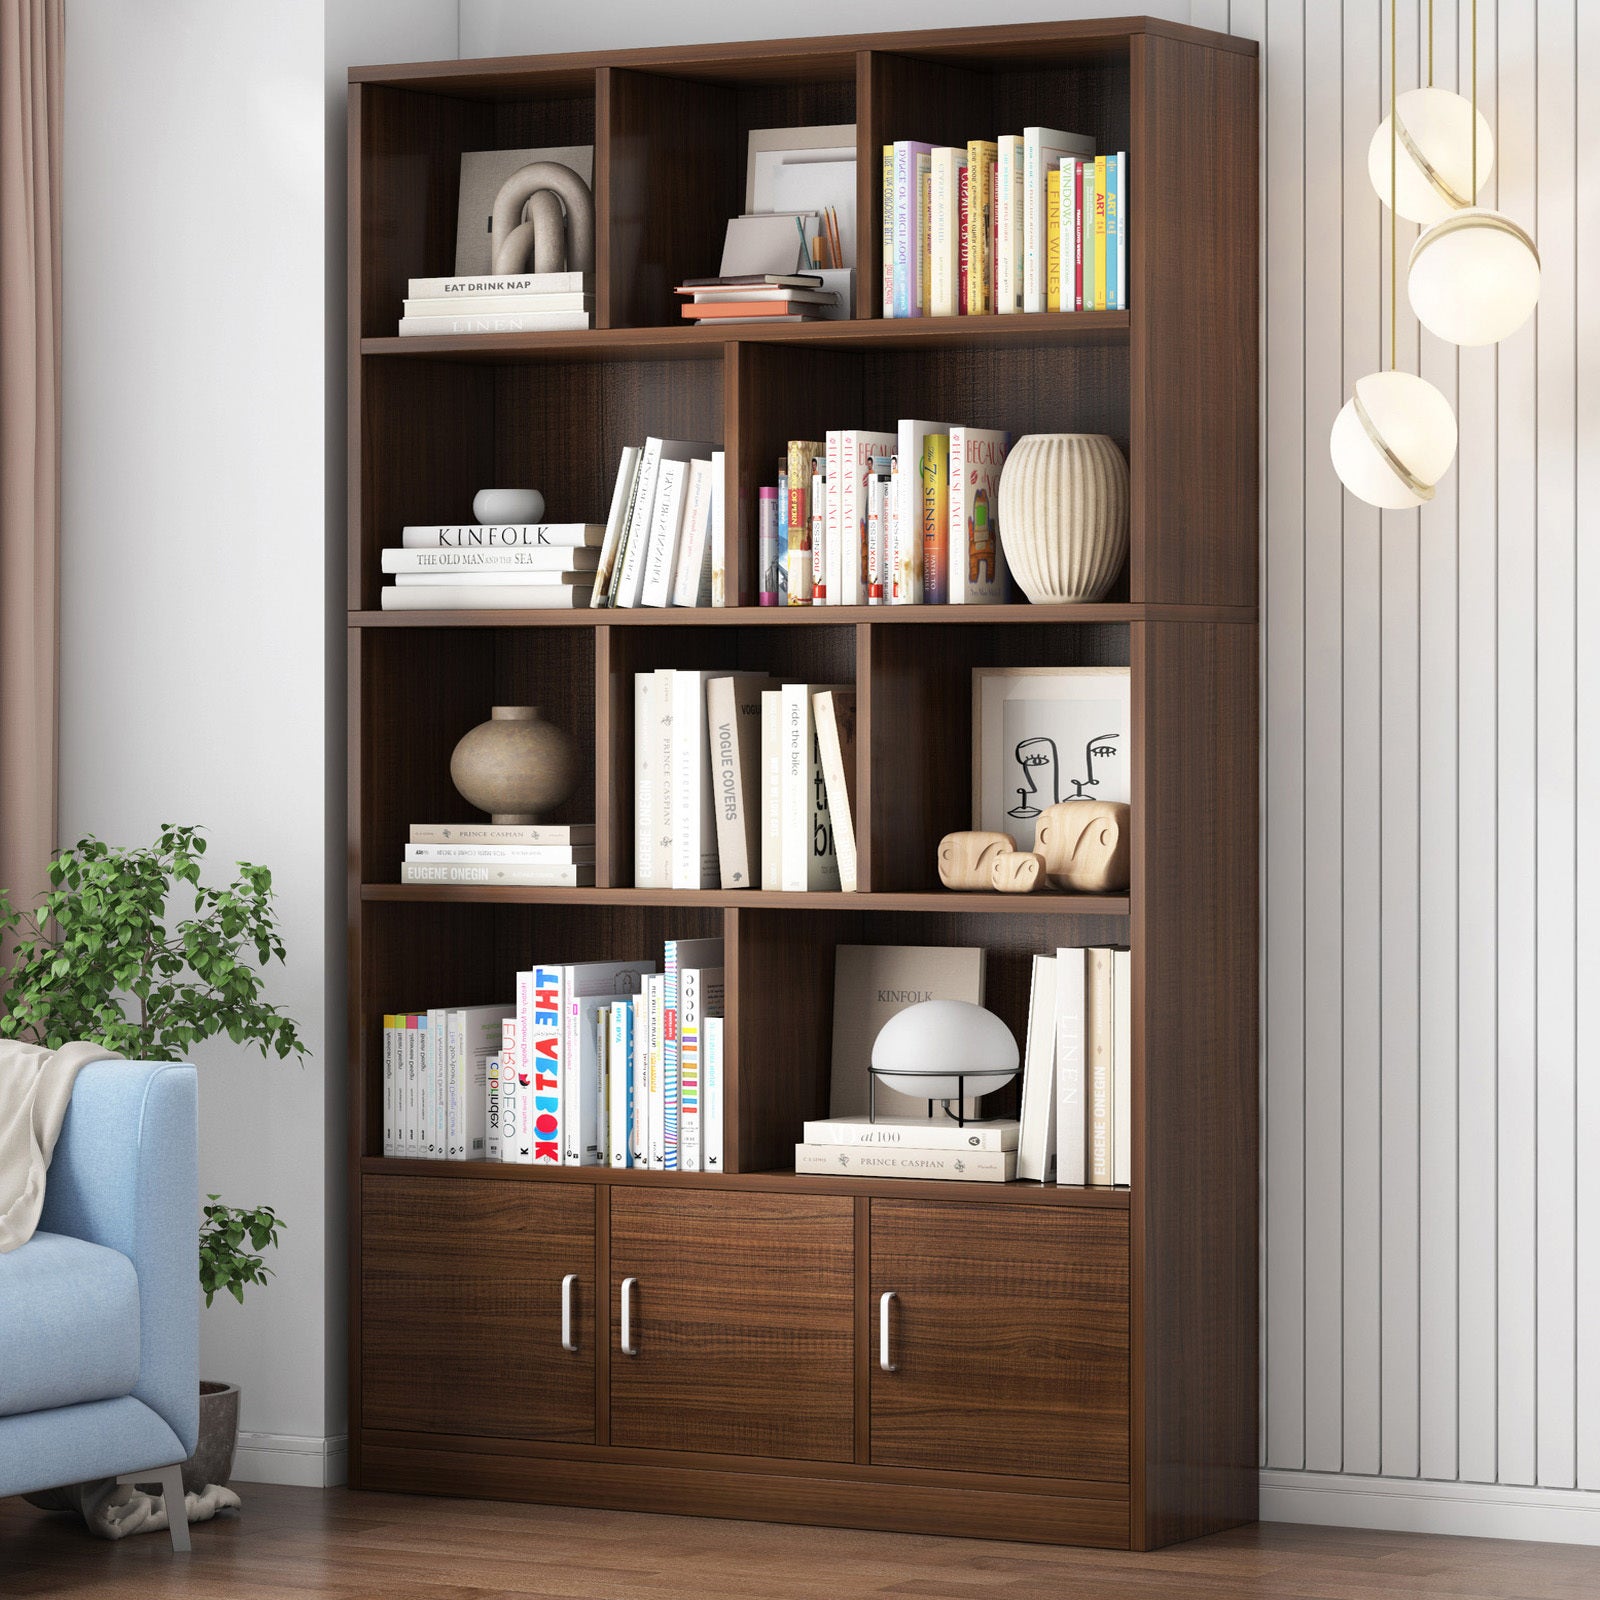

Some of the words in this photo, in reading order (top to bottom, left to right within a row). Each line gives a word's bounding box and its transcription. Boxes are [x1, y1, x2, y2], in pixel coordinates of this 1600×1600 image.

[1050, 191, 1060, 229] FINE
[1062, 163, 1072, 226] WINDOWS
[1096, 193, 1104, 217] ART
[1107, 192, 1116, 217] ART
[1050, 236, 1060, 295] WINES
[444, 284, 466, 293] EAT
[468, 282, 504, 292] DRINK
[507, 281, 531, 290] NAP
[452, 319, 524, 333] LINEN
[925, 487, 936, 542] SENSE
[439, 526, 551, 547] KINFOLK
[416, 554, 437, 566] THE
[439, 553, 461, 565] OLD
[462, 553, 484, 565] MAN
[514, 552, 533, 564] SEA
[791, 703, 800, 726] ride
[718, 723, 733, 767] VOGUE
[791, 730, 800, 748] the
[663, 738, 671, 776] PRINCE
[791, 752, 800, 776] bike
[639, 779, 652, 827] ONEGIN
[663, 780, 671, 826] CASPIAN
[722, 769, 738, 821] COVERS
[639, 828, 652, 878] EUGENE
[408, 867, 448, 880] EUGENE
[450, 867, 489, 881] ONEGIN
[877, 990, 933, 1003] KINFOLK
[1063, 1013, 1078, 1104] LINEN
[1094, 1065, 1106, 1118] ONEGIN
[860, 1131, 874, 1142] at
[877, 1131, 901, 1143] 100
[1094, 1121, 1106, 1176] EUGENE
[860, 1157, 897, 1167] PRINCE
[901, 1158, 945, 1169] CASPIAN
